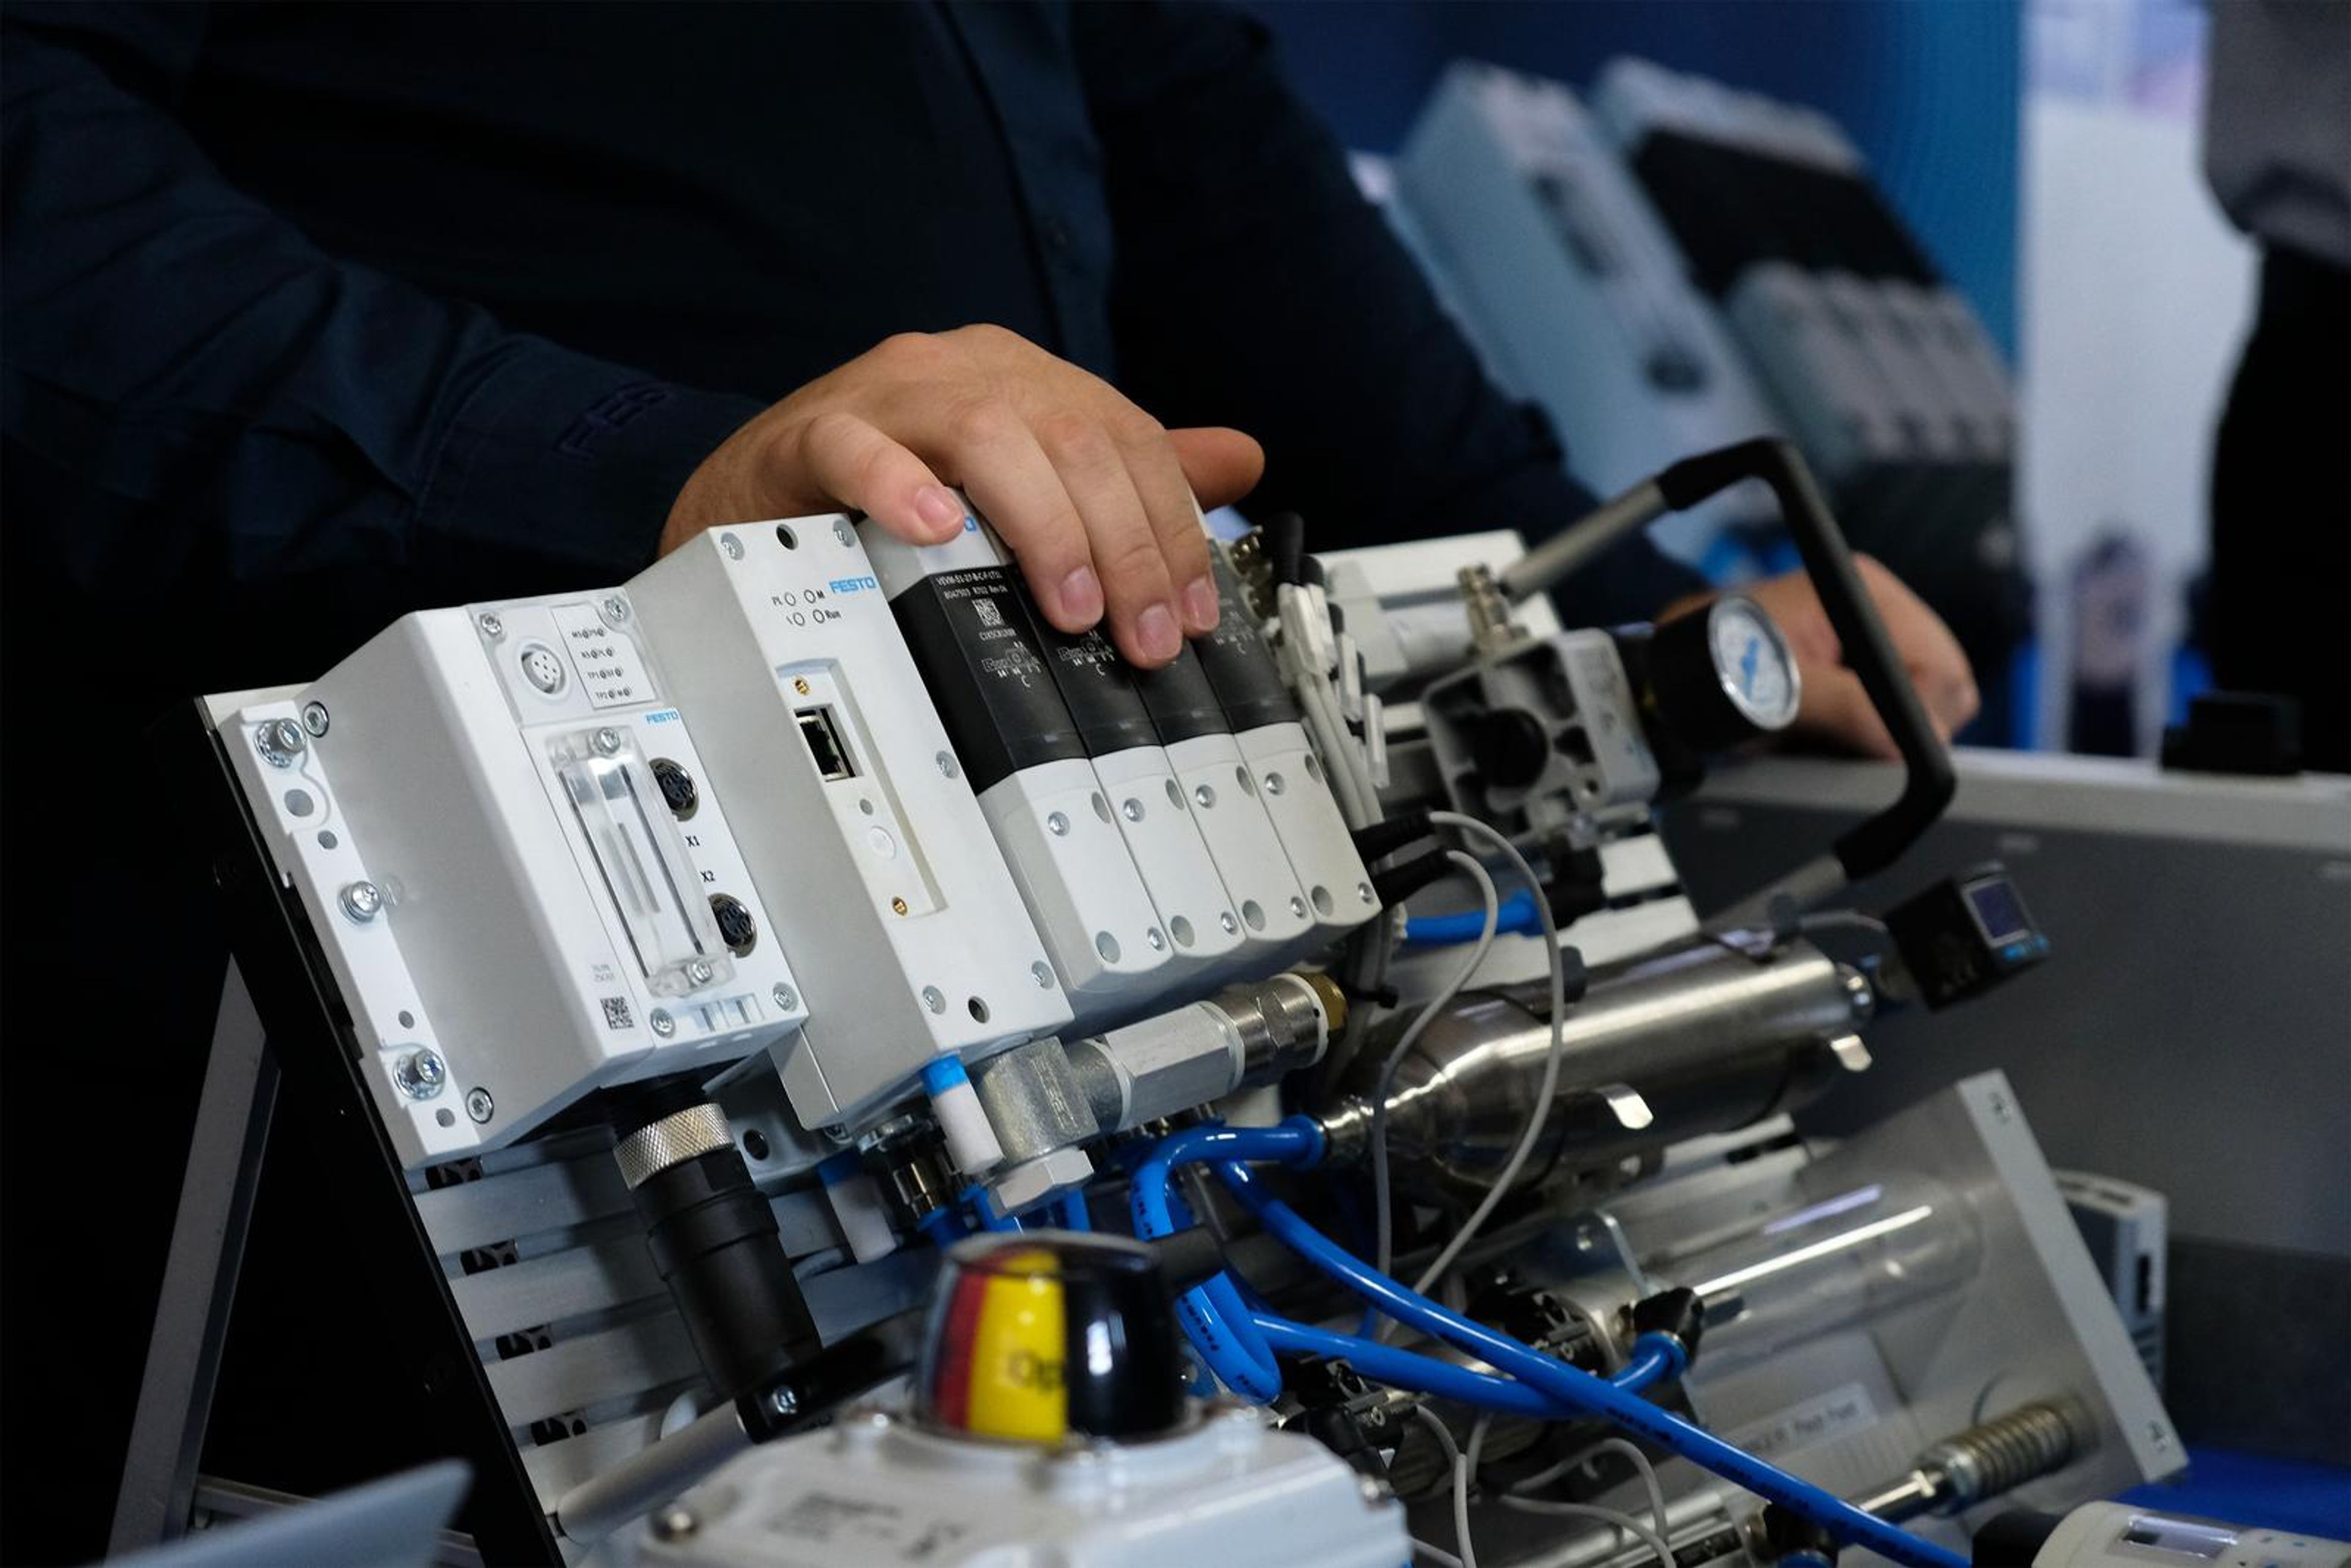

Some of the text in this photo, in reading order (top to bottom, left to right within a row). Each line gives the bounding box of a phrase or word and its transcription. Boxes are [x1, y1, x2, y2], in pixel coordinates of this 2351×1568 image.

[829, 577, 876, 593] FESTO
[646, 711, 678, 724] FESTO
[685, 835, 700, 847] X1
[700, 870, 716, 882] X2
